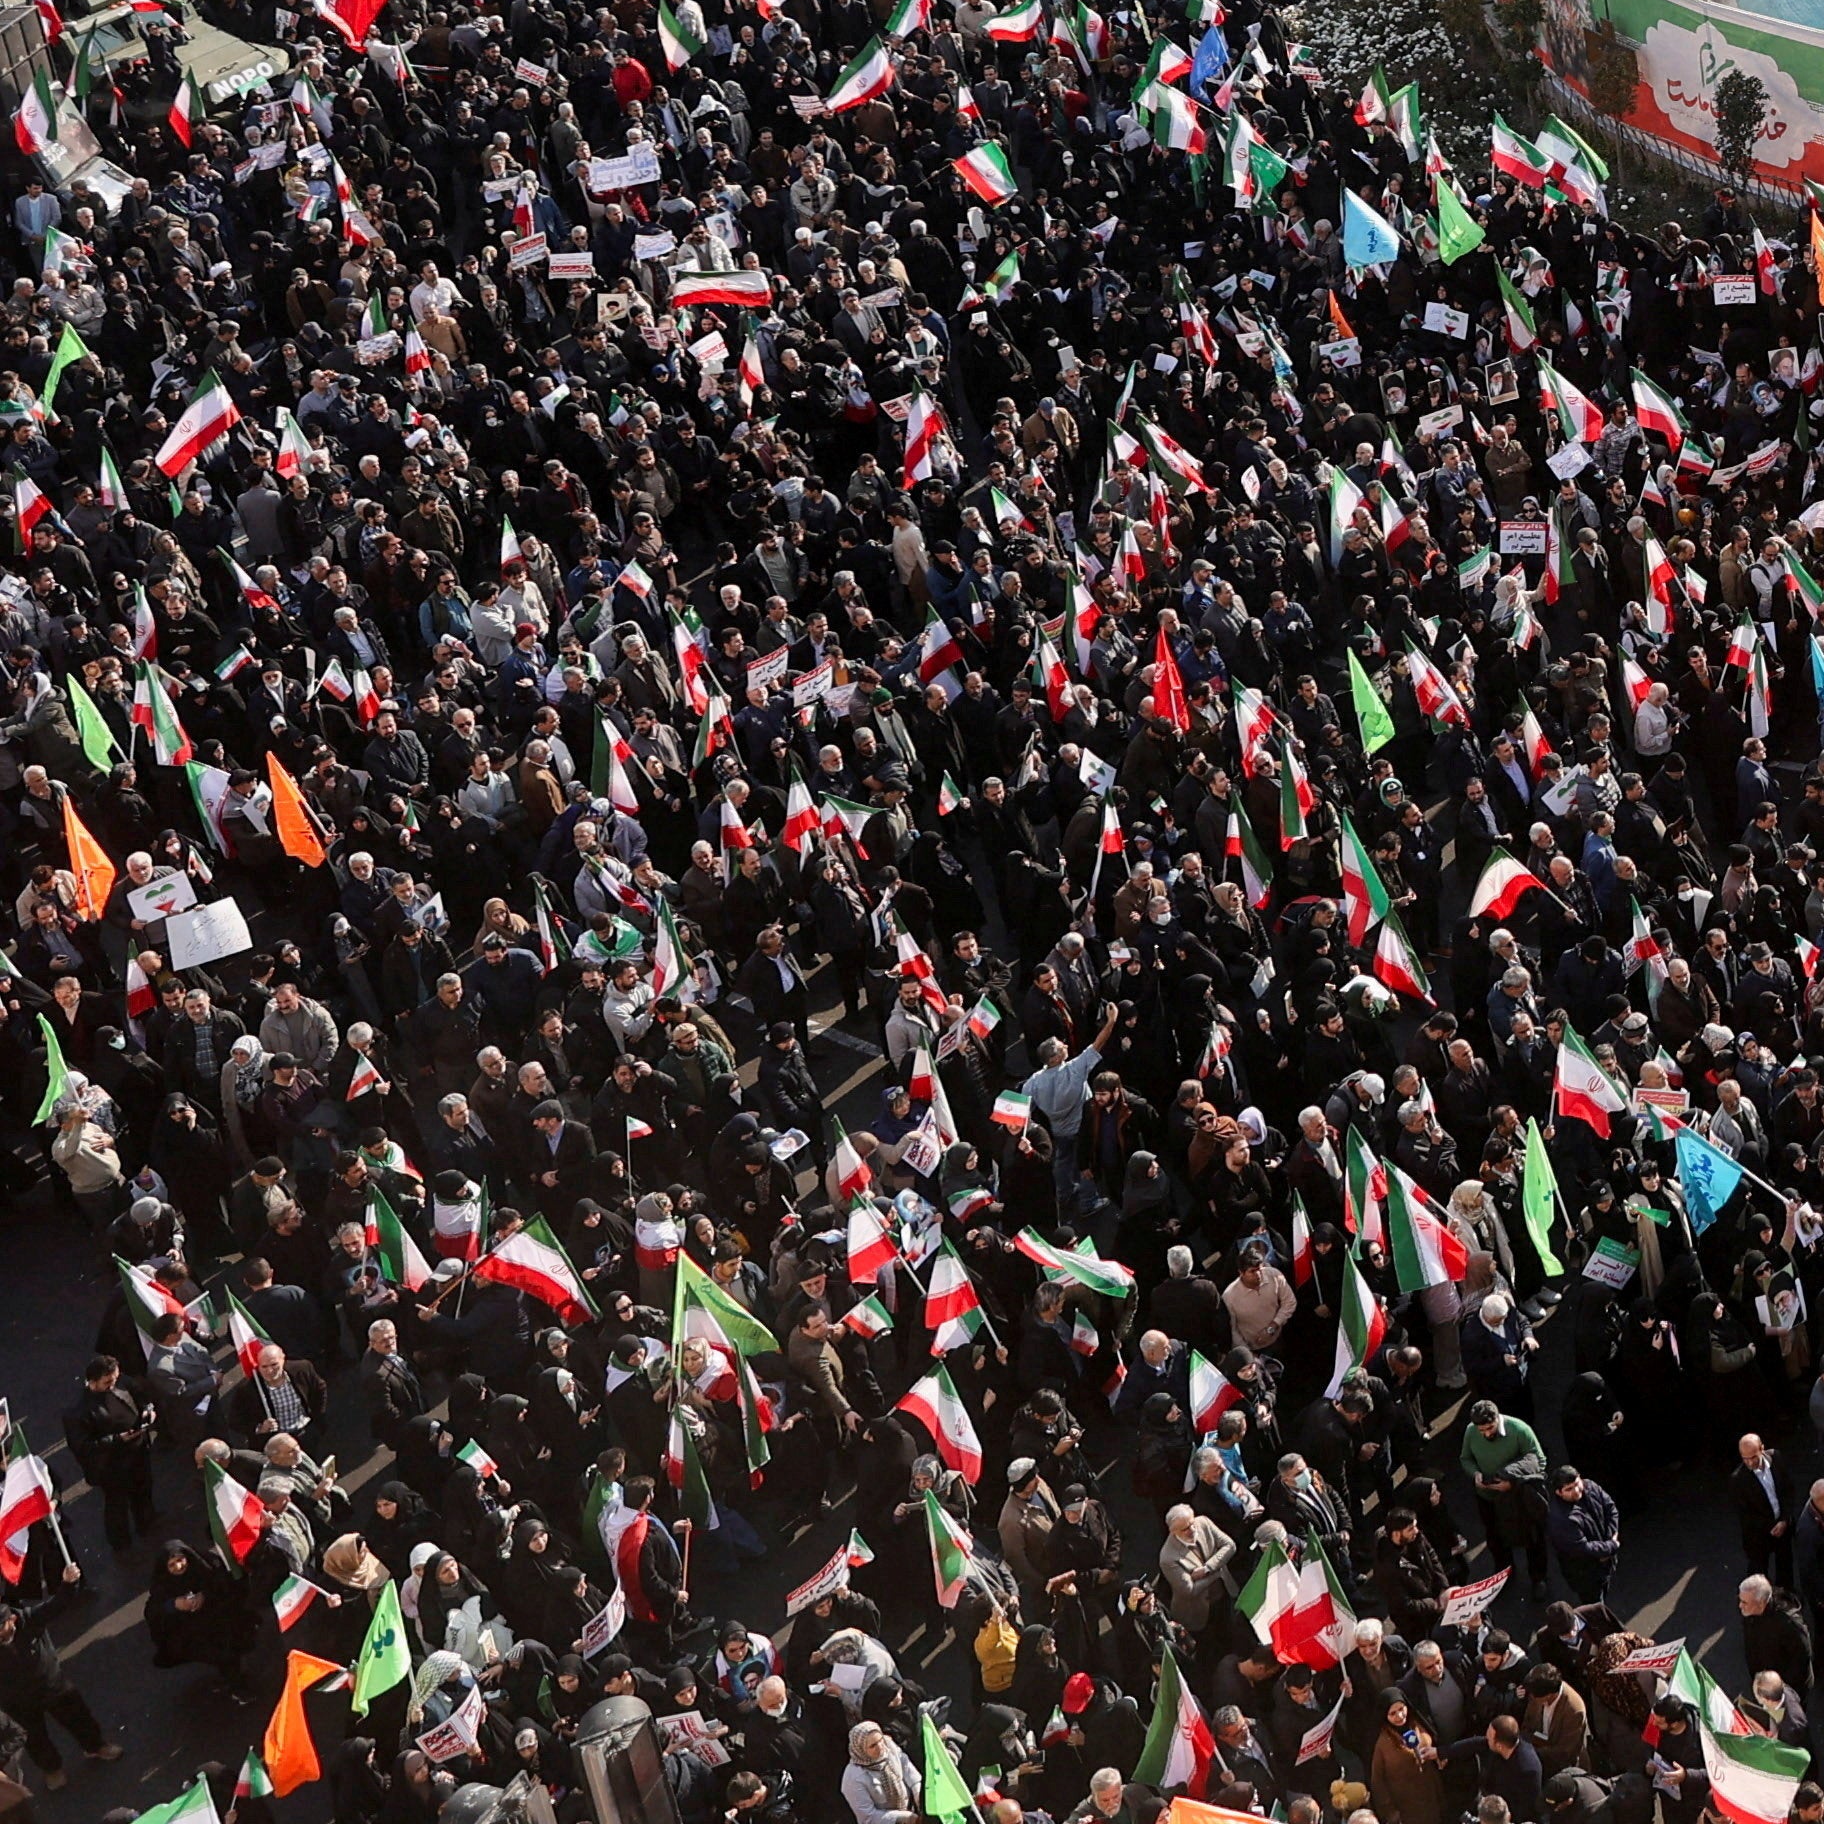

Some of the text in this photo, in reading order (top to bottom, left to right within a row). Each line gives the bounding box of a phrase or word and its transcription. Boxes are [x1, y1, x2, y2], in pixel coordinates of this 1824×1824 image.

[1700, 42, 1735, 87] مردم
[214, 63, 274, 97] NOPO
[1506, 533, 1517, 541] امر
[1455, 1598, 1473, 1611] امر
